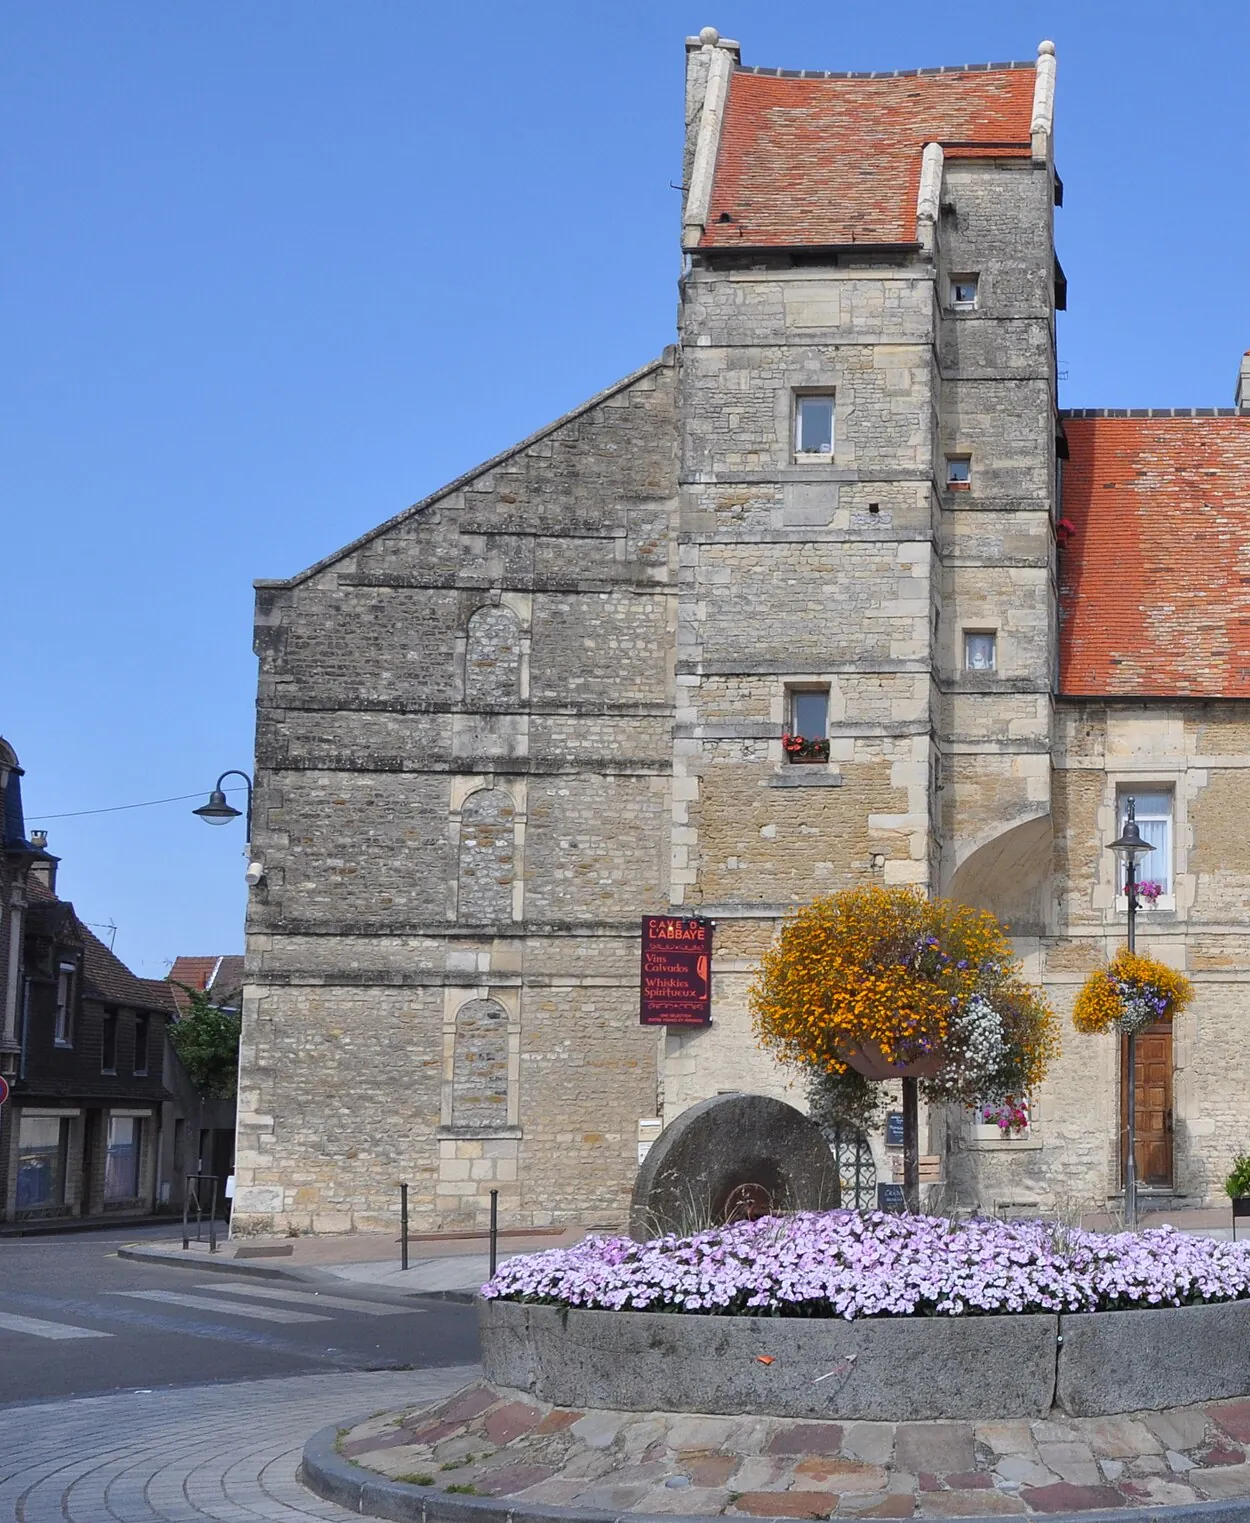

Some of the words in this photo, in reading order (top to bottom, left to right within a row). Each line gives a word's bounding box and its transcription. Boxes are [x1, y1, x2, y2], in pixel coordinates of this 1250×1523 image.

[649, 920, 682, 929] CAVE
[690, 921, 705, 929] D
[649, 928, 705, 940] L'ABBAYE
[645, 953, 667, 963] Vins
[644, 962, 689, 973] Calvados
[645, 977, 689, 988] Whiskies
[644, 987, 696, 998] Spiritueux
